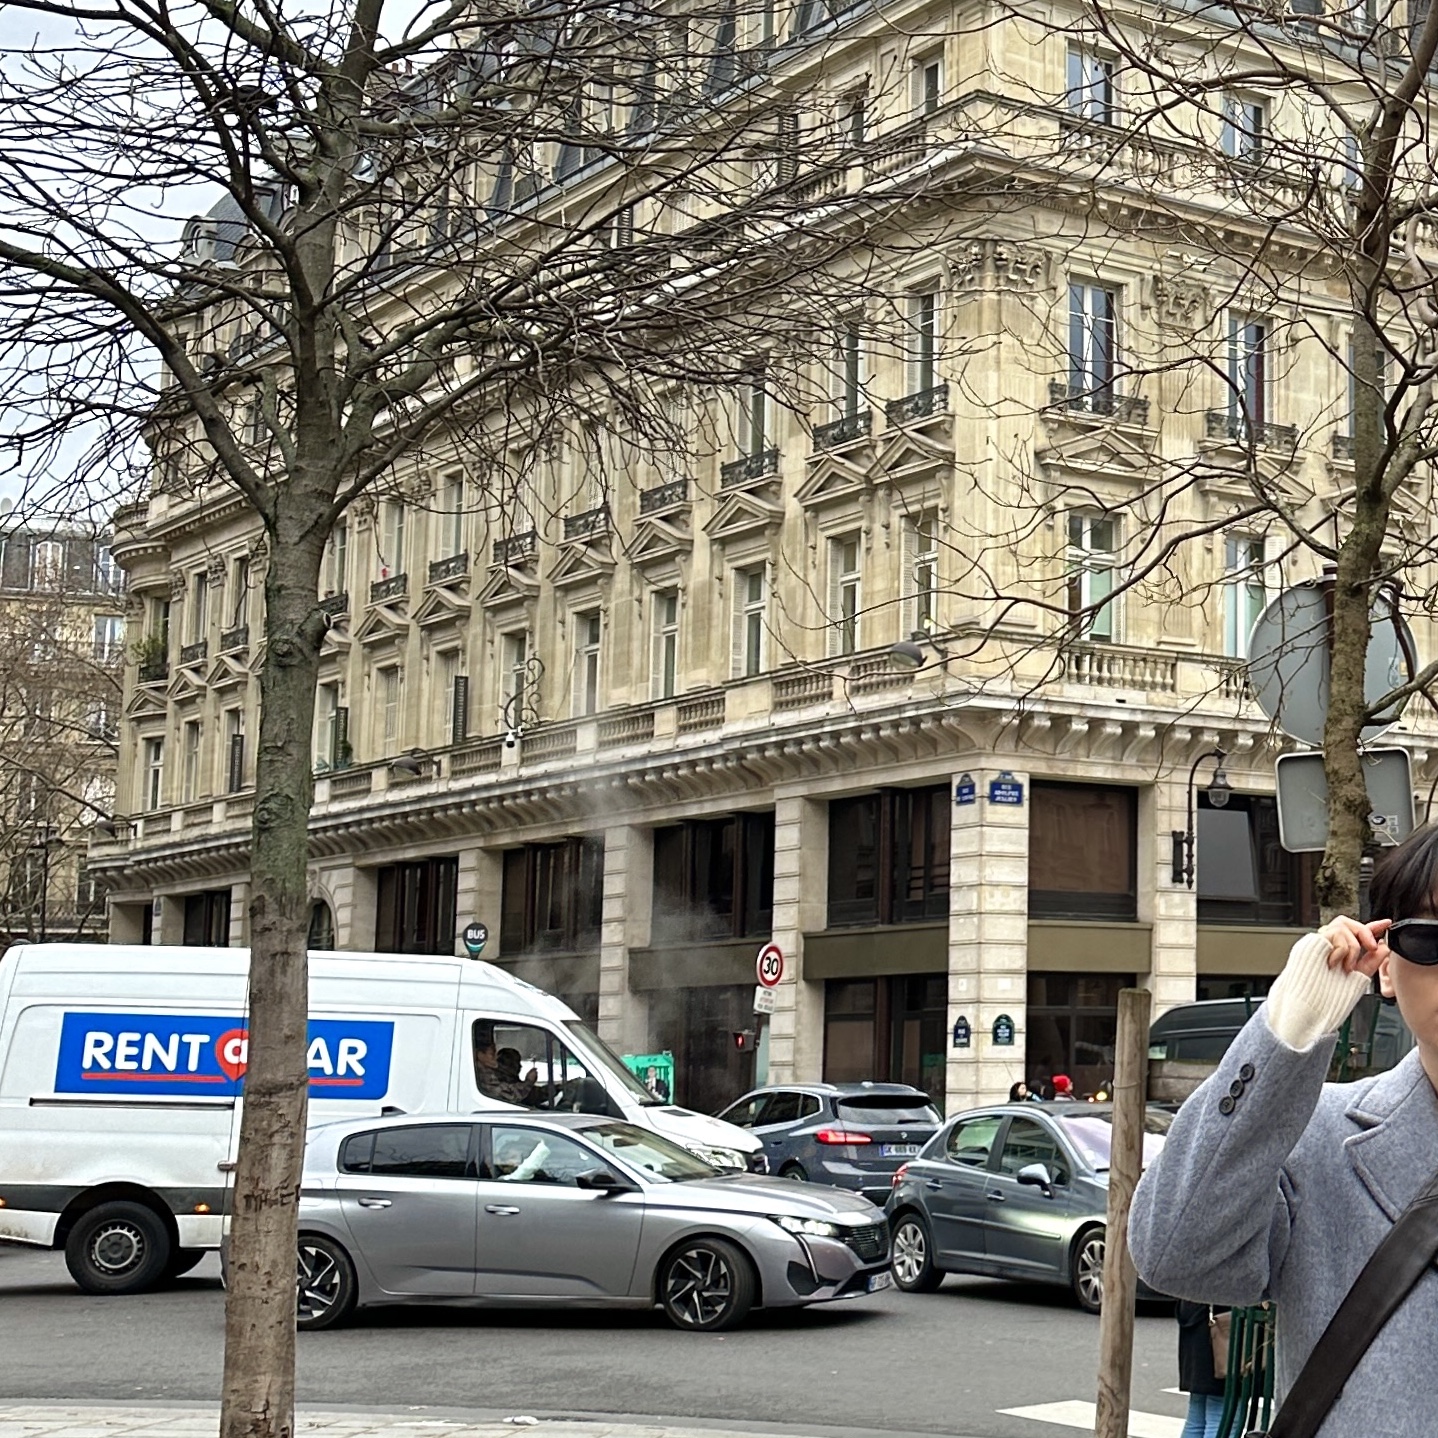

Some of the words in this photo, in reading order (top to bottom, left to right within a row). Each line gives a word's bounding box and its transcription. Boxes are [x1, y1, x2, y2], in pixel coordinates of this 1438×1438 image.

[467, 929, 485, 939] BUS
[763, 956, 779, 976] 30
[82, 1031, 210, 1072] RENT
[306, 1036, 368, 1077] AR
